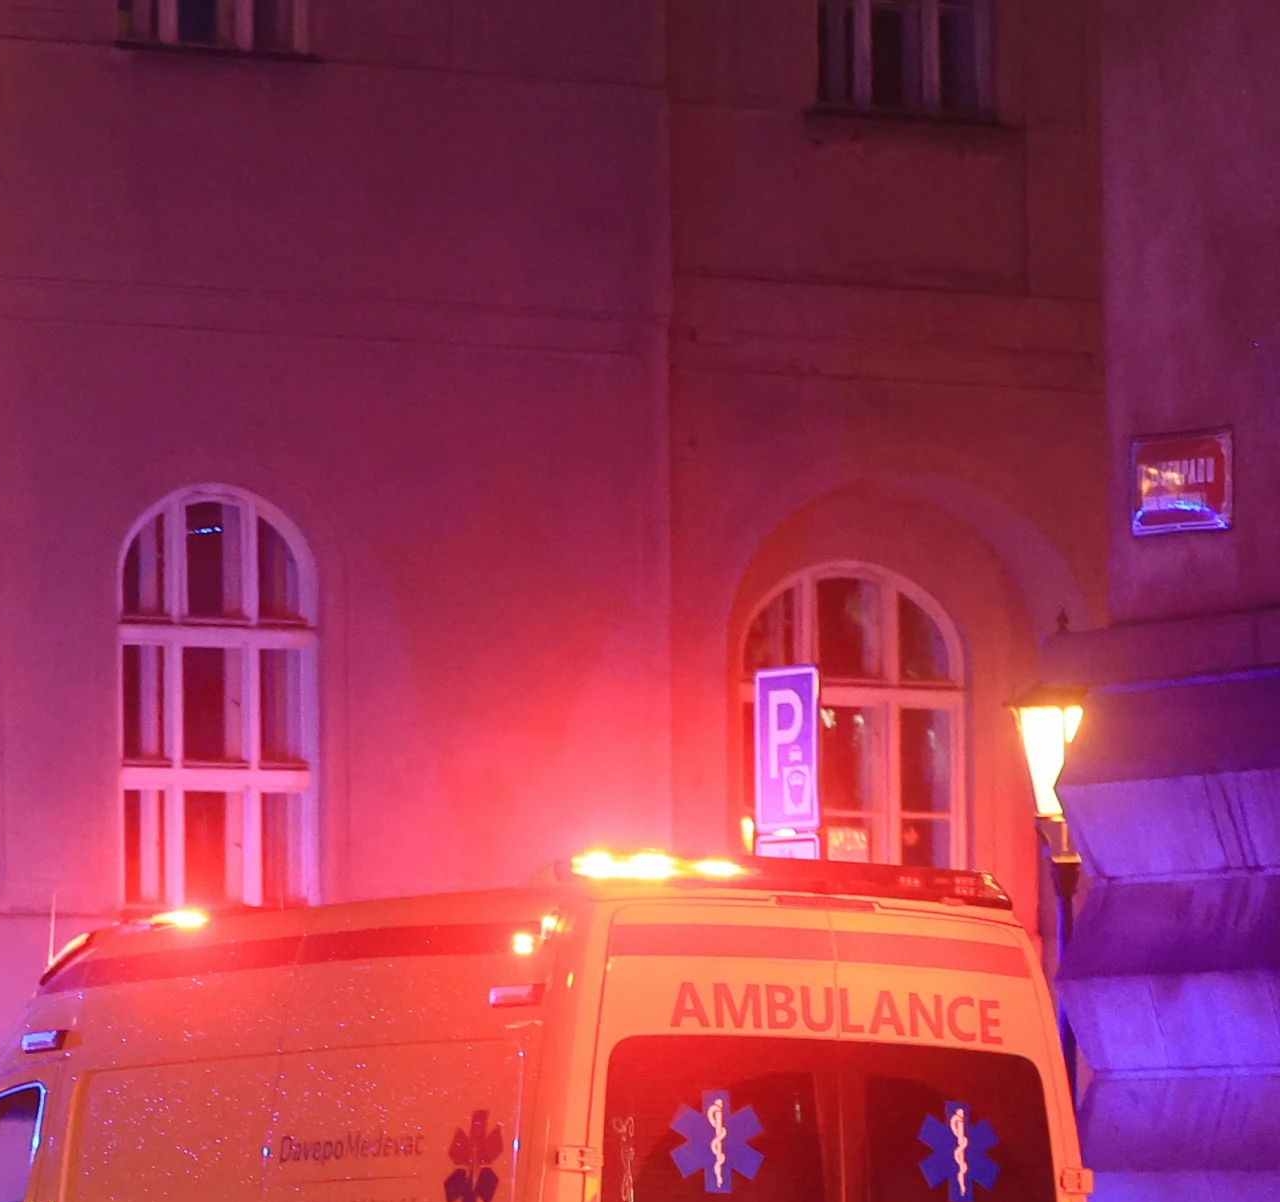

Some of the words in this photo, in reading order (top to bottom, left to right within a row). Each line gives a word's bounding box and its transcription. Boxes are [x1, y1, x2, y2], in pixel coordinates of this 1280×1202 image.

[768, 689, 804, 780] P
[669, 981, 1004, 1046] AMBULANCE
[278, 1131, 425, 1165] DavepoMedevac
